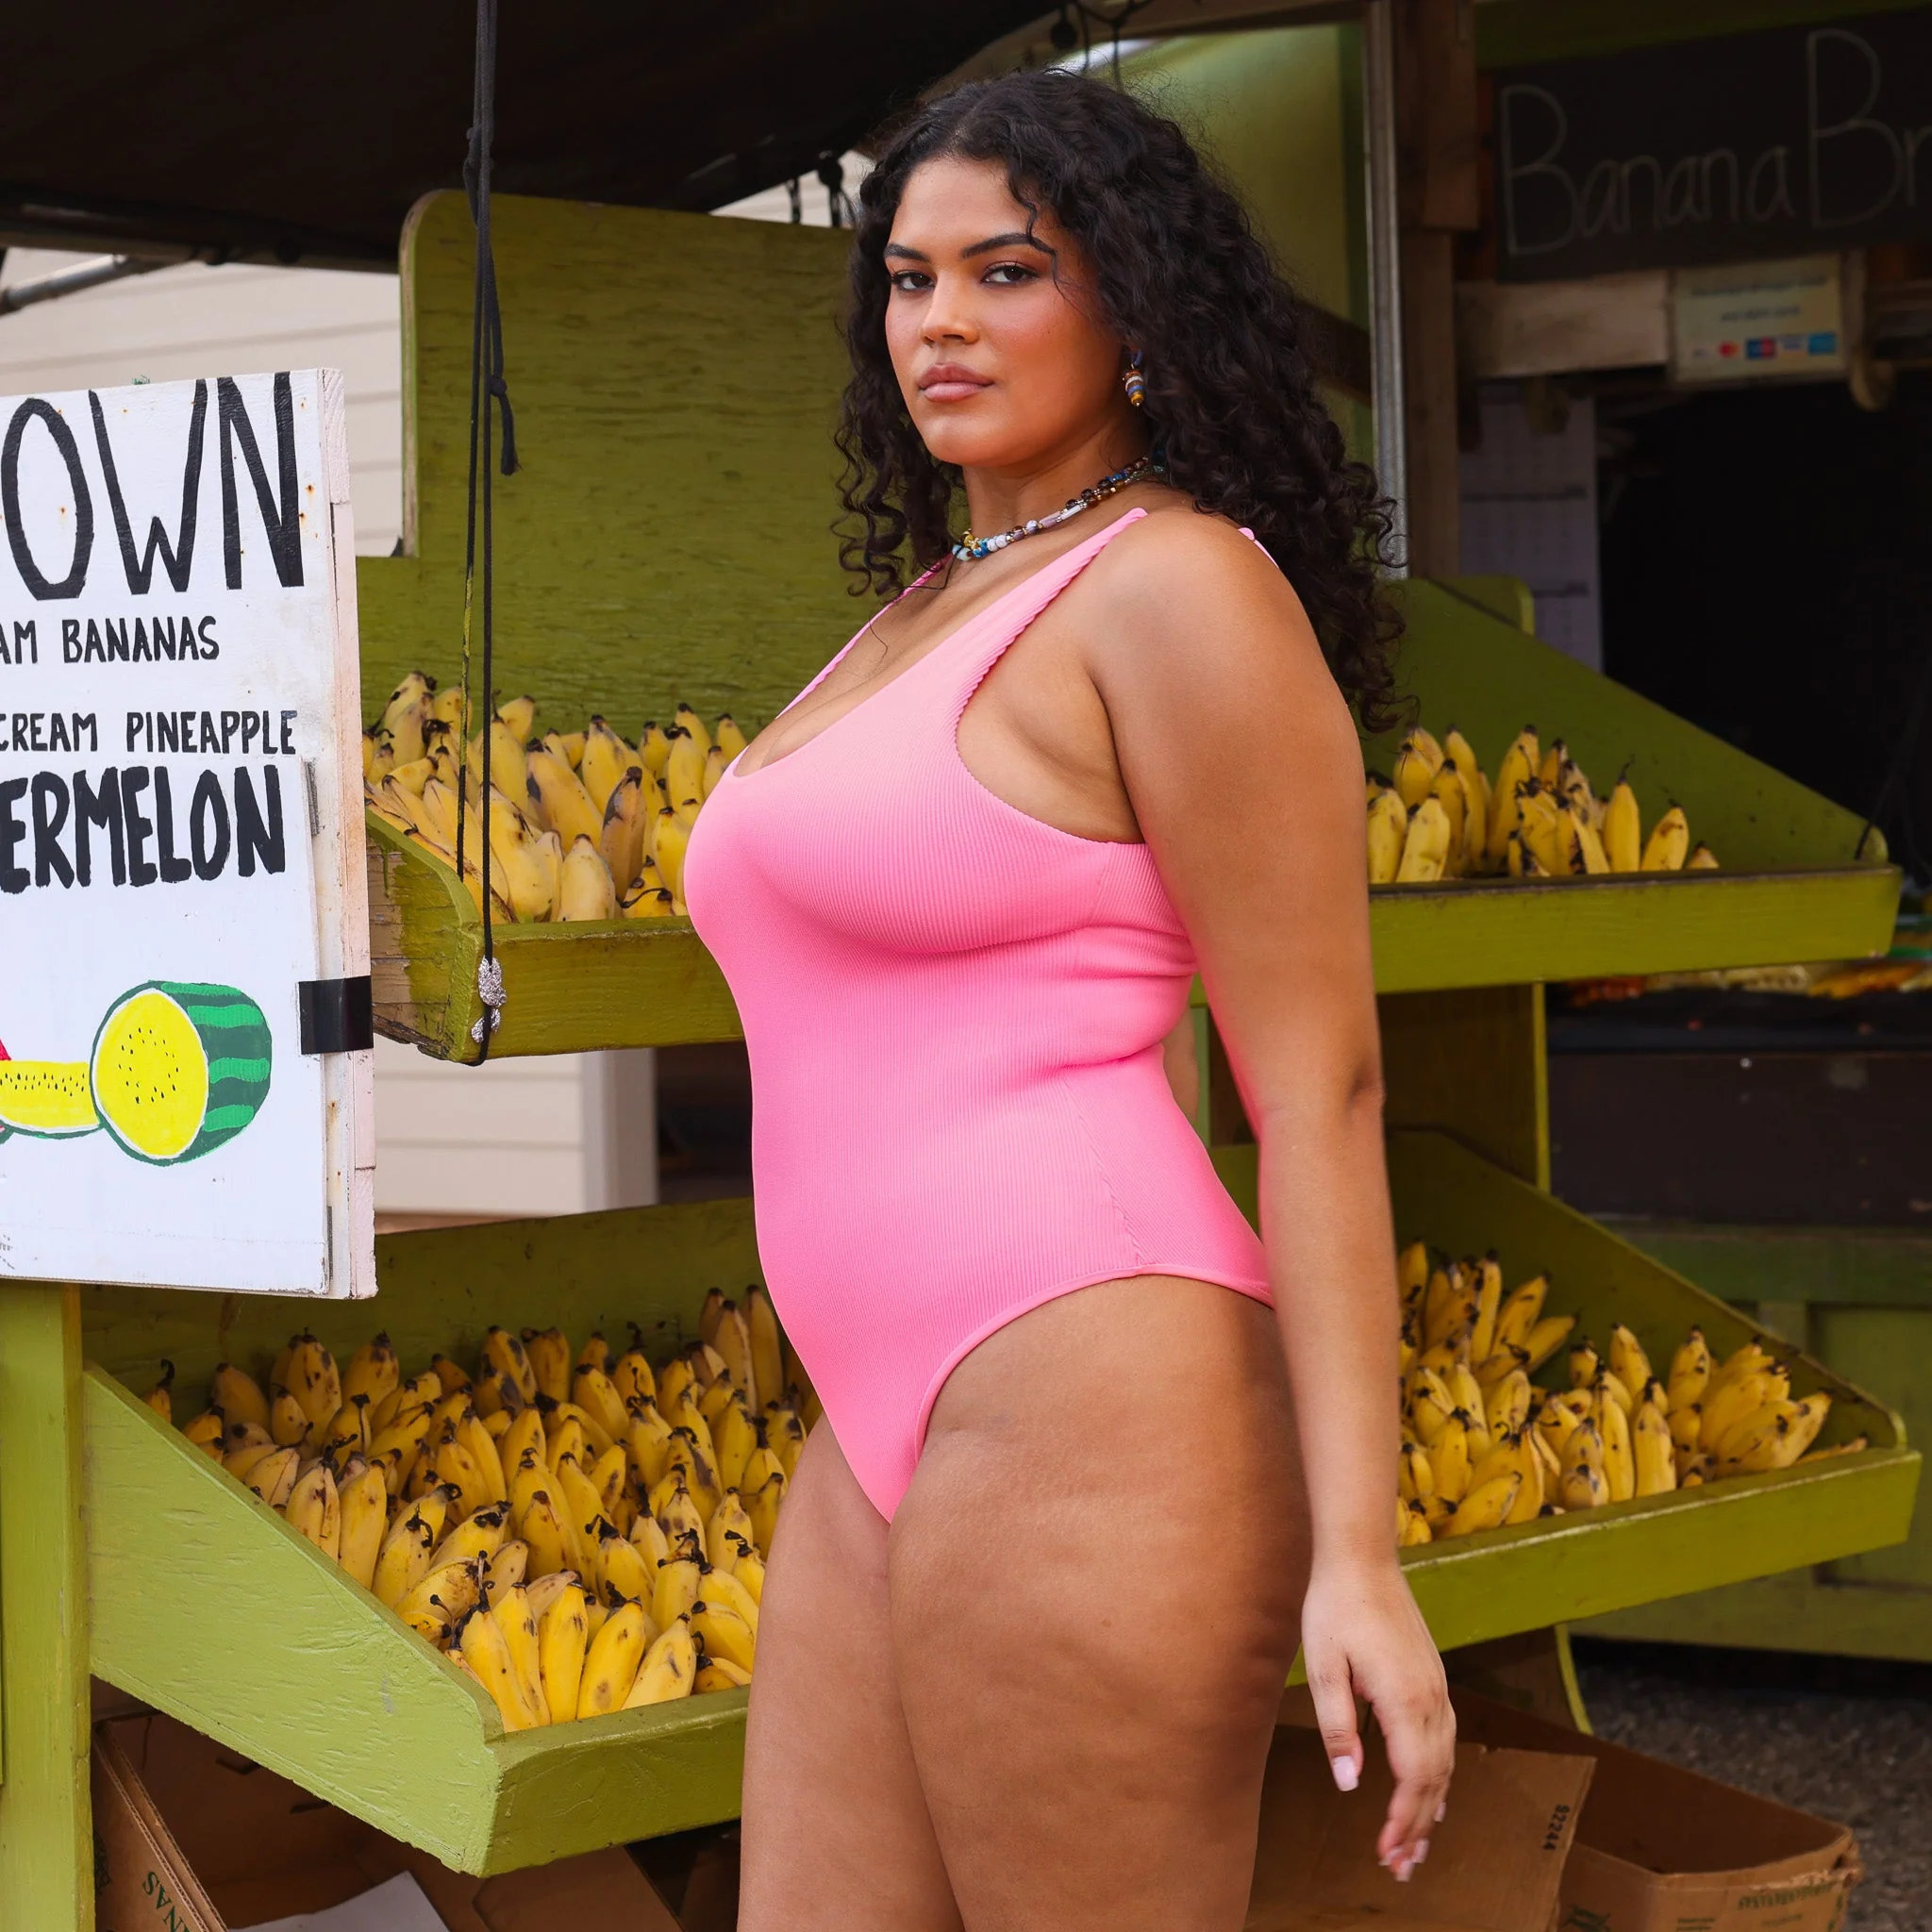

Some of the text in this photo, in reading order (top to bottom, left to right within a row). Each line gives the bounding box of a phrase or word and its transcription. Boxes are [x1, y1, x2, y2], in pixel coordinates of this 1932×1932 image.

[1500, 83, 1798, 256] Banana
[1, 371, 304, 601] OWN
[62, 616, 220, 664] BANANAS
[126, 709, 297, 756] PINEAPPLE
[0, 764, 286, 894] ERMELON
